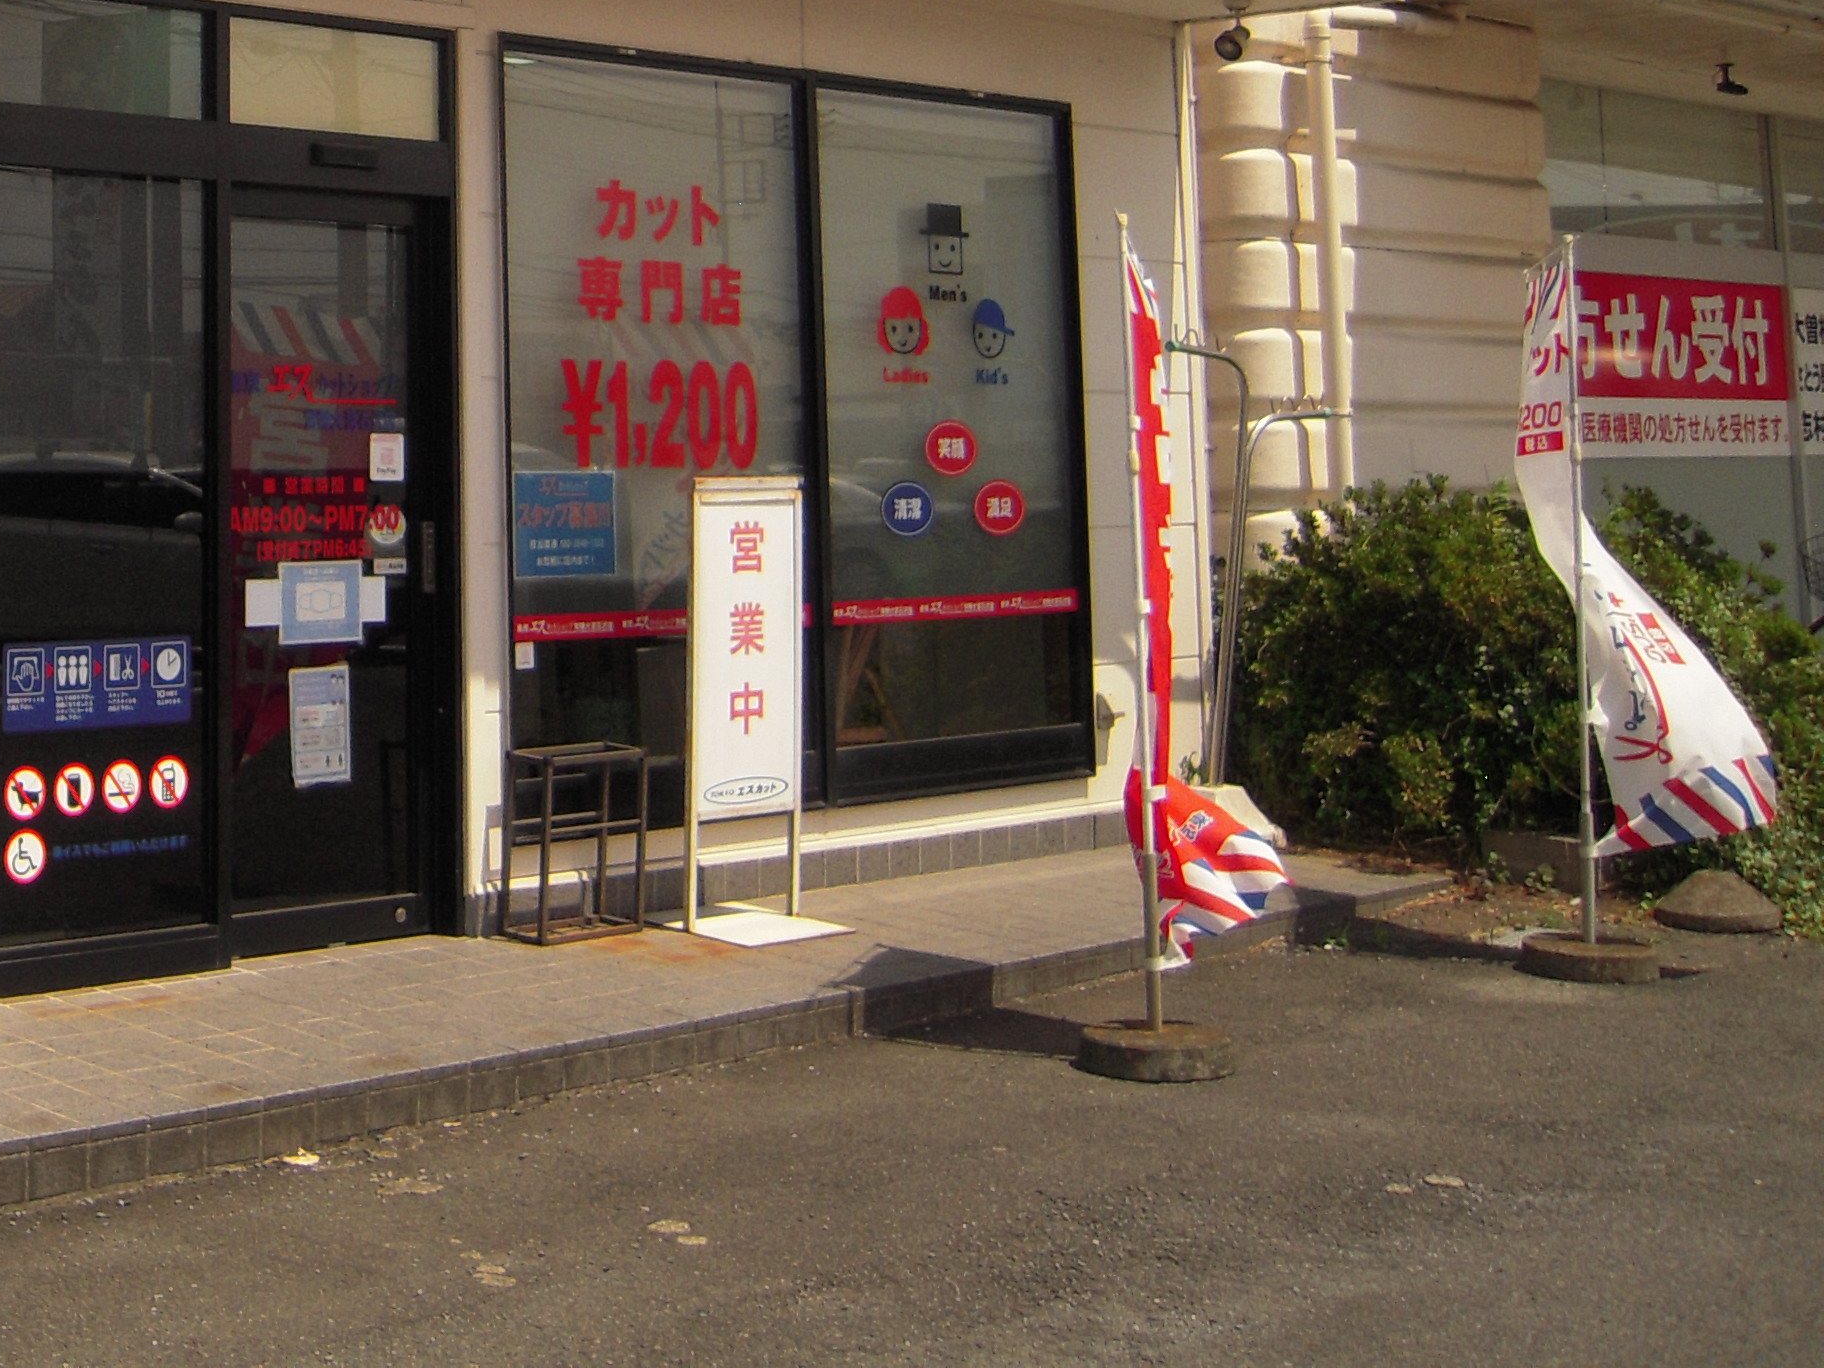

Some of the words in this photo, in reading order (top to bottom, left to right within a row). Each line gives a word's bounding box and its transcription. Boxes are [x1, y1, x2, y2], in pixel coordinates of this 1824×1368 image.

[596, 179, 720, 246] カット
[577, 256, 742, 327] 専門店
[929, 284, 967, 303] Men's
[883, 367, 929, 384] Ladies
[976, 367, 1008, 385] Kid's
[563, 358, 759, 472] ¥1,200
[937, 437, 966, 459] 笑顔
[729, 521, 764, 735] 営業中
